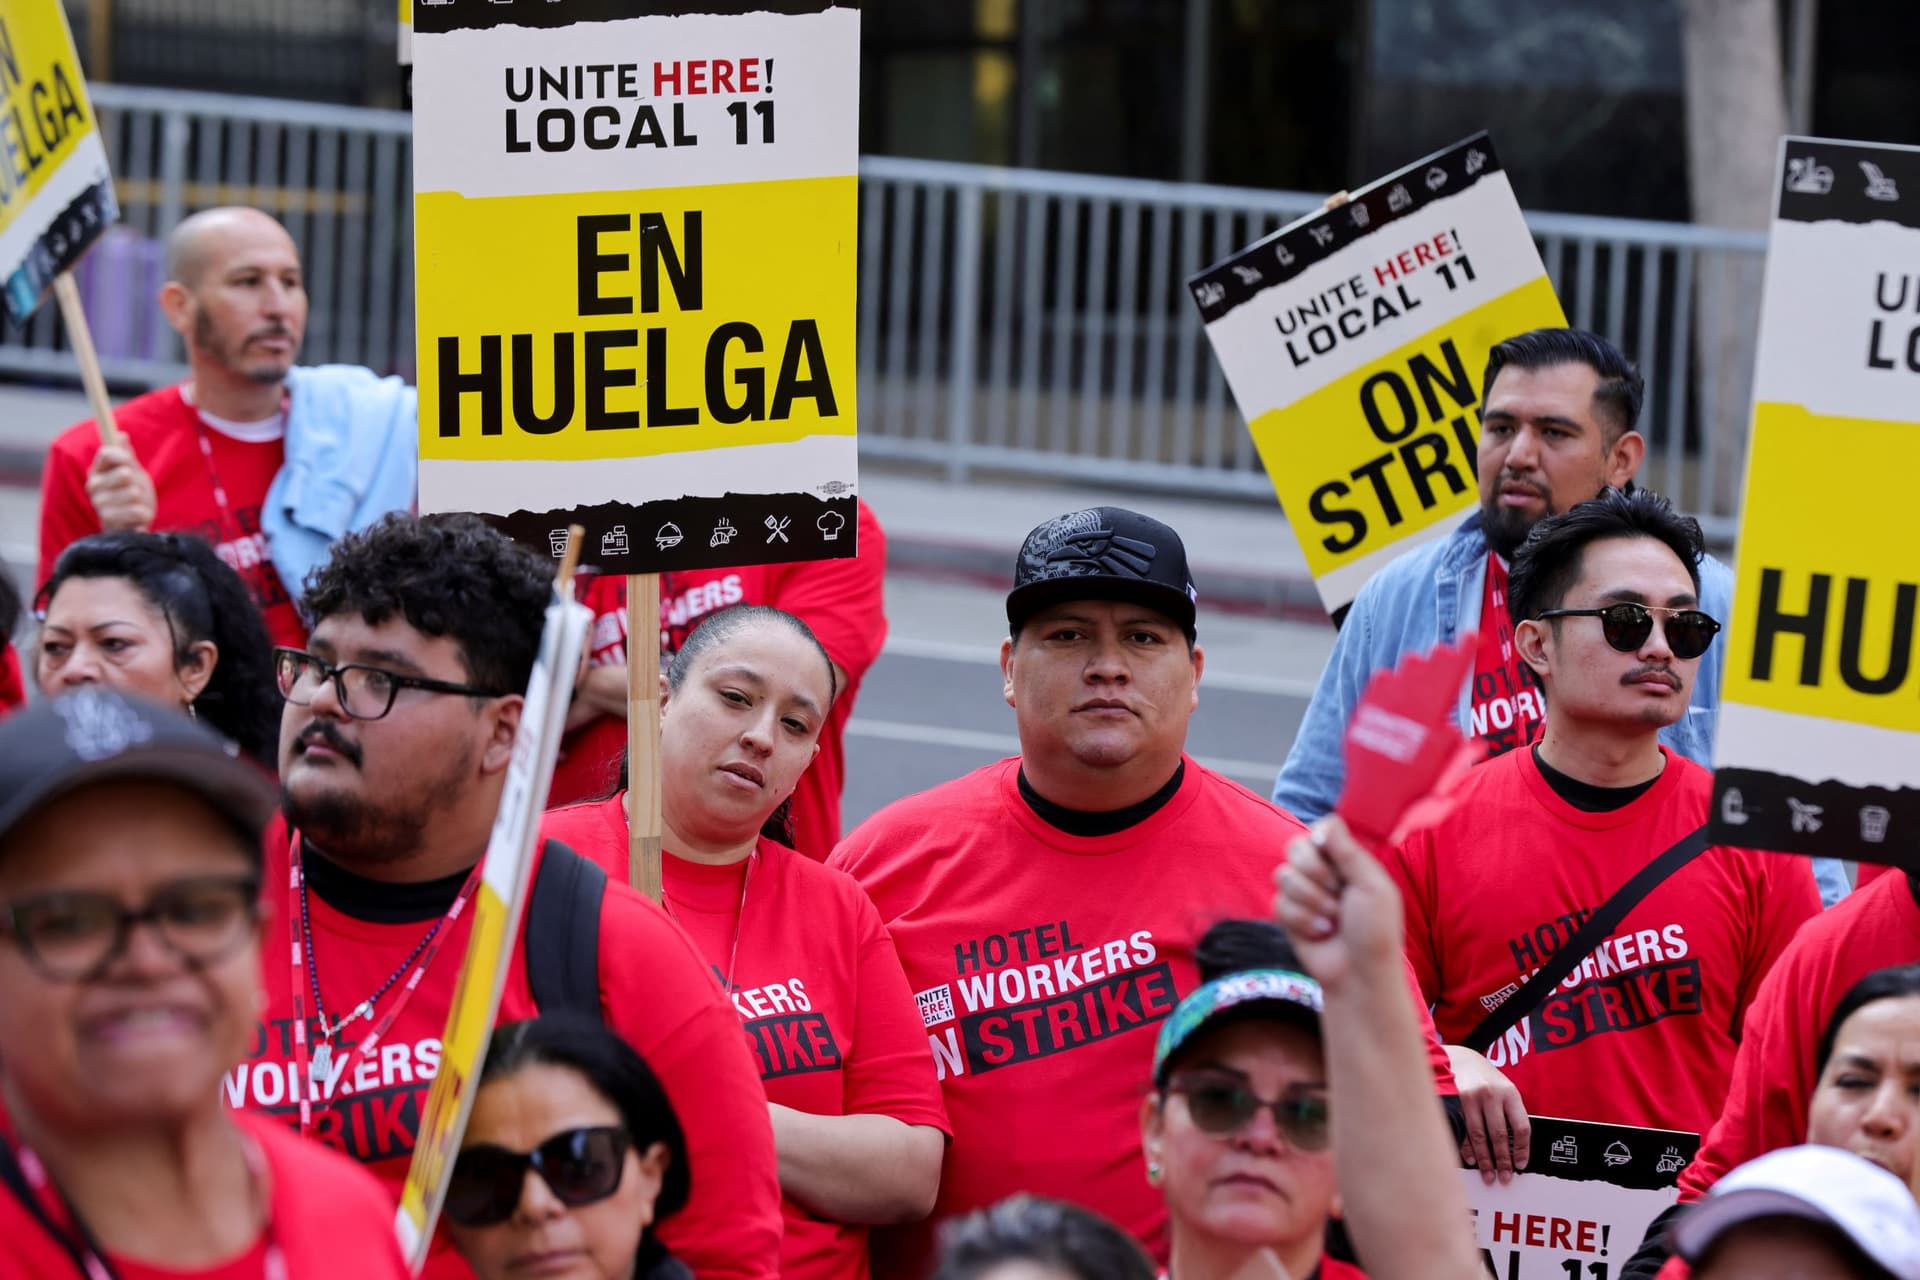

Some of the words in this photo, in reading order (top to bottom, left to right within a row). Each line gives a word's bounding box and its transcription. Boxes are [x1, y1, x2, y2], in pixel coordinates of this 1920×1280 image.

[505, 64, 638, 102] UNITE
[654, 58, 774, 97] HERE!
[0, 62, 85, 205] ELGA
[505, 102, 698, 153] LOCAL
[726, 100, 775, 145] 11
[577, 211, 703, 316] EN
[1275, 273, 1369, 335] UNITE
[1373, 228, 1462, 287] HERE!
[1285, 284, 1422, 368] LOCAL
[1434, 253, 1476, 290] 11
[438, 319, 839, 437] HUELGA
[1359, 339, 1477, 445] ON
[1309, 407, 1481, 554] STRI
[1750, 567, 1920, 695] HU
[954, 920, 1083, 974] HOTEL
[957, 931, 1157, 1012] WORKERS
[731, 978, 812, 1019] KERS
[921, 998, 950, 1017] ERE!
[924, 1013, 942, 1025] CAL
[928, 1027, 964, 1081] N
[978, 970, 1172, 1065] STRIKE
[1482, 984, 1517, 1006] UNITE
[1542, 966, 1697, 1044] STRIKE
[743, 1019, 836, 1074] RIKE
[1493, 1211, 1611, 1257] HERE!
